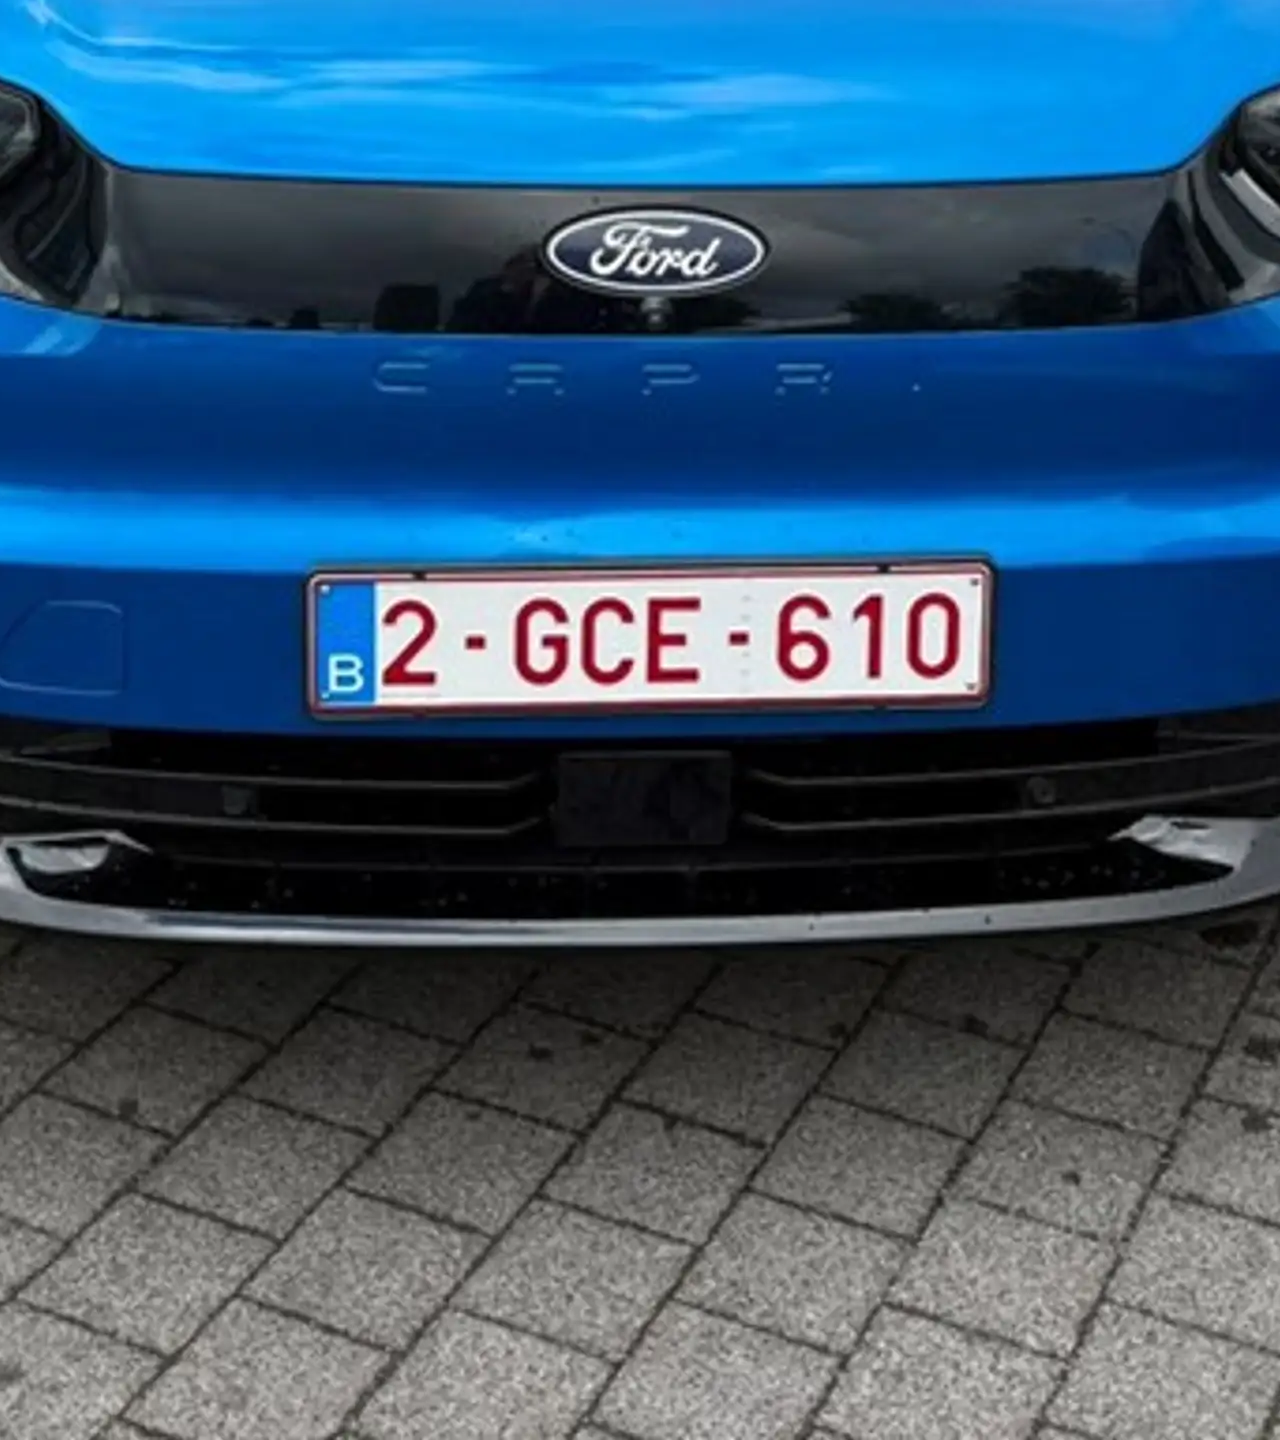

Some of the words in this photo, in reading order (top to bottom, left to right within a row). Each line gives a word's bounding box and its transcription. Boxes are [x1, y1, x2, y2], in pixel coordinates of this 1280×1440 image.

[589, 220, 722, 278] Ford
[381, 592, 961, 687] 2-GCE-610
[328, 653, 365, 693] B
